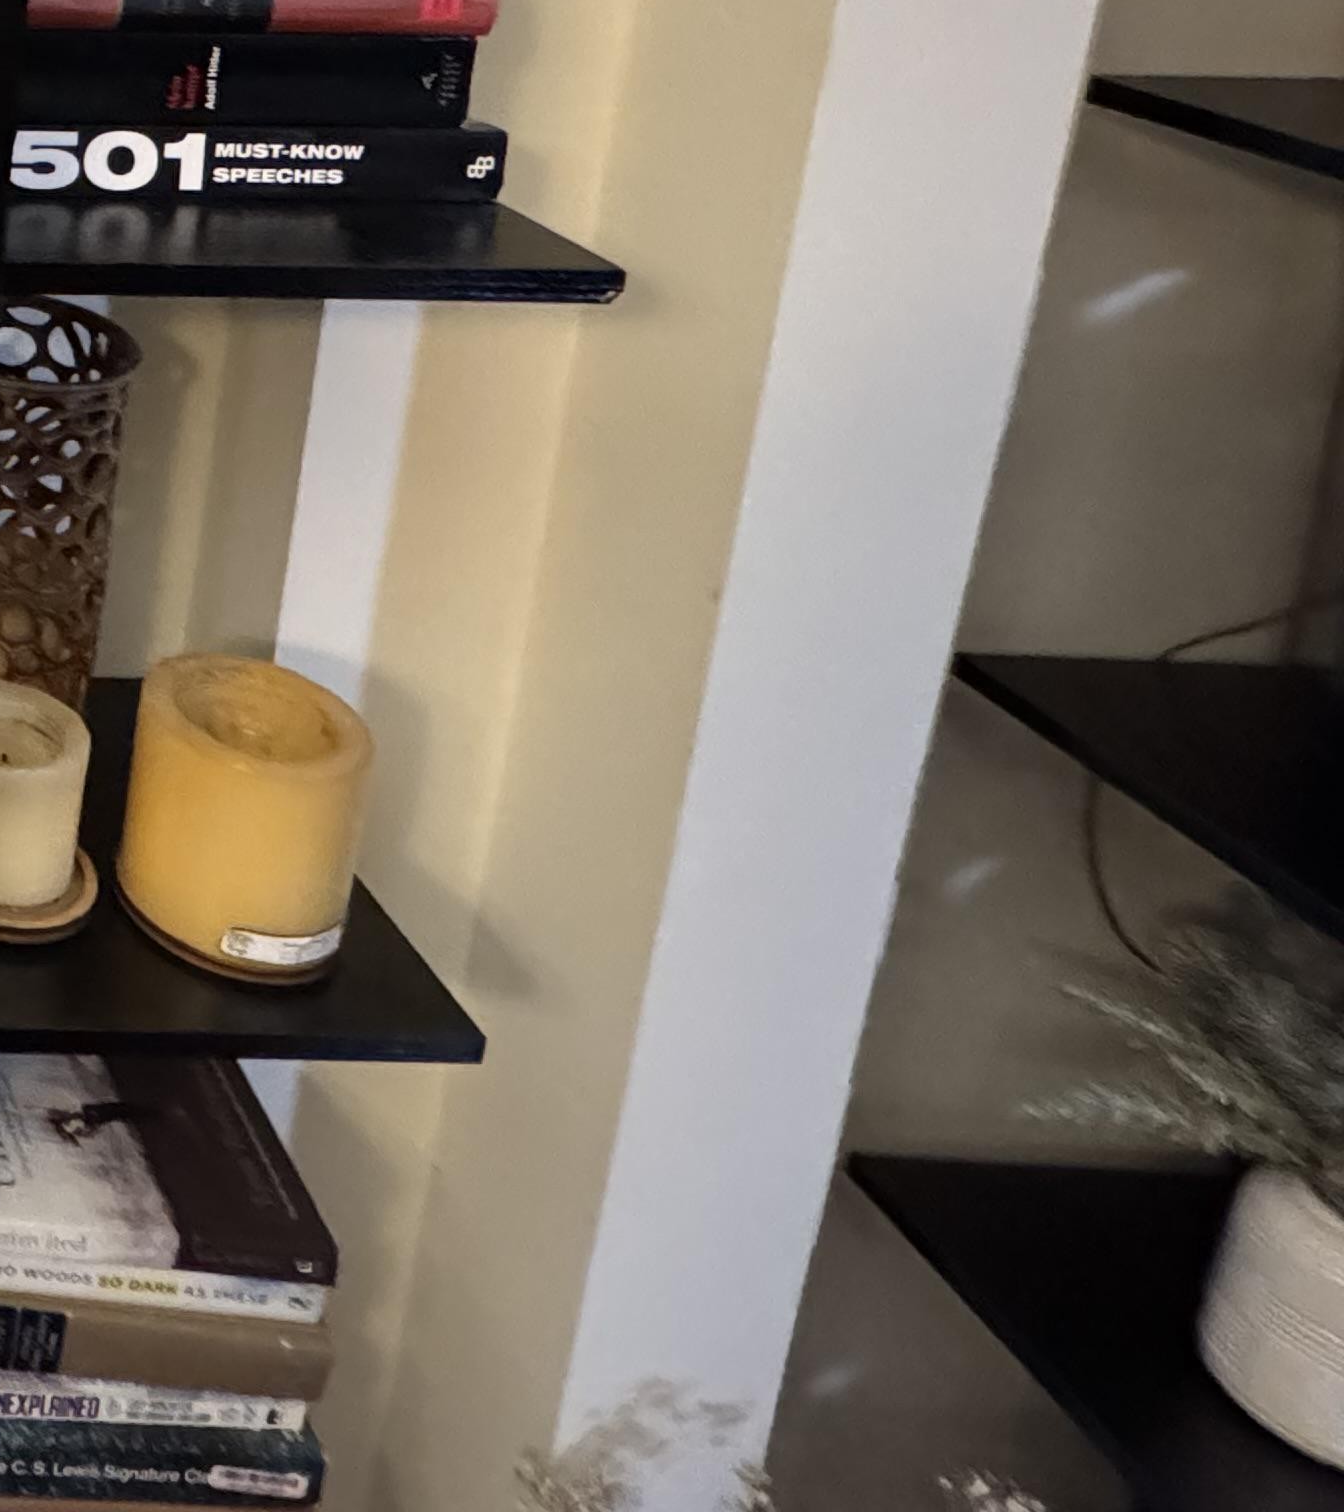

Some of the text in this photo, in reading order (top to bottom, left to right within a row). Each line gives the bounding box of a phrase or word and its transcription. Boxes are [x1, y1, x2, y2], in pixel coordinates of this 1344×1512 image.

[10, 130, 365, 192] 501 MUST-KNOW
[212, 168, 344, 185] SPEECHES
